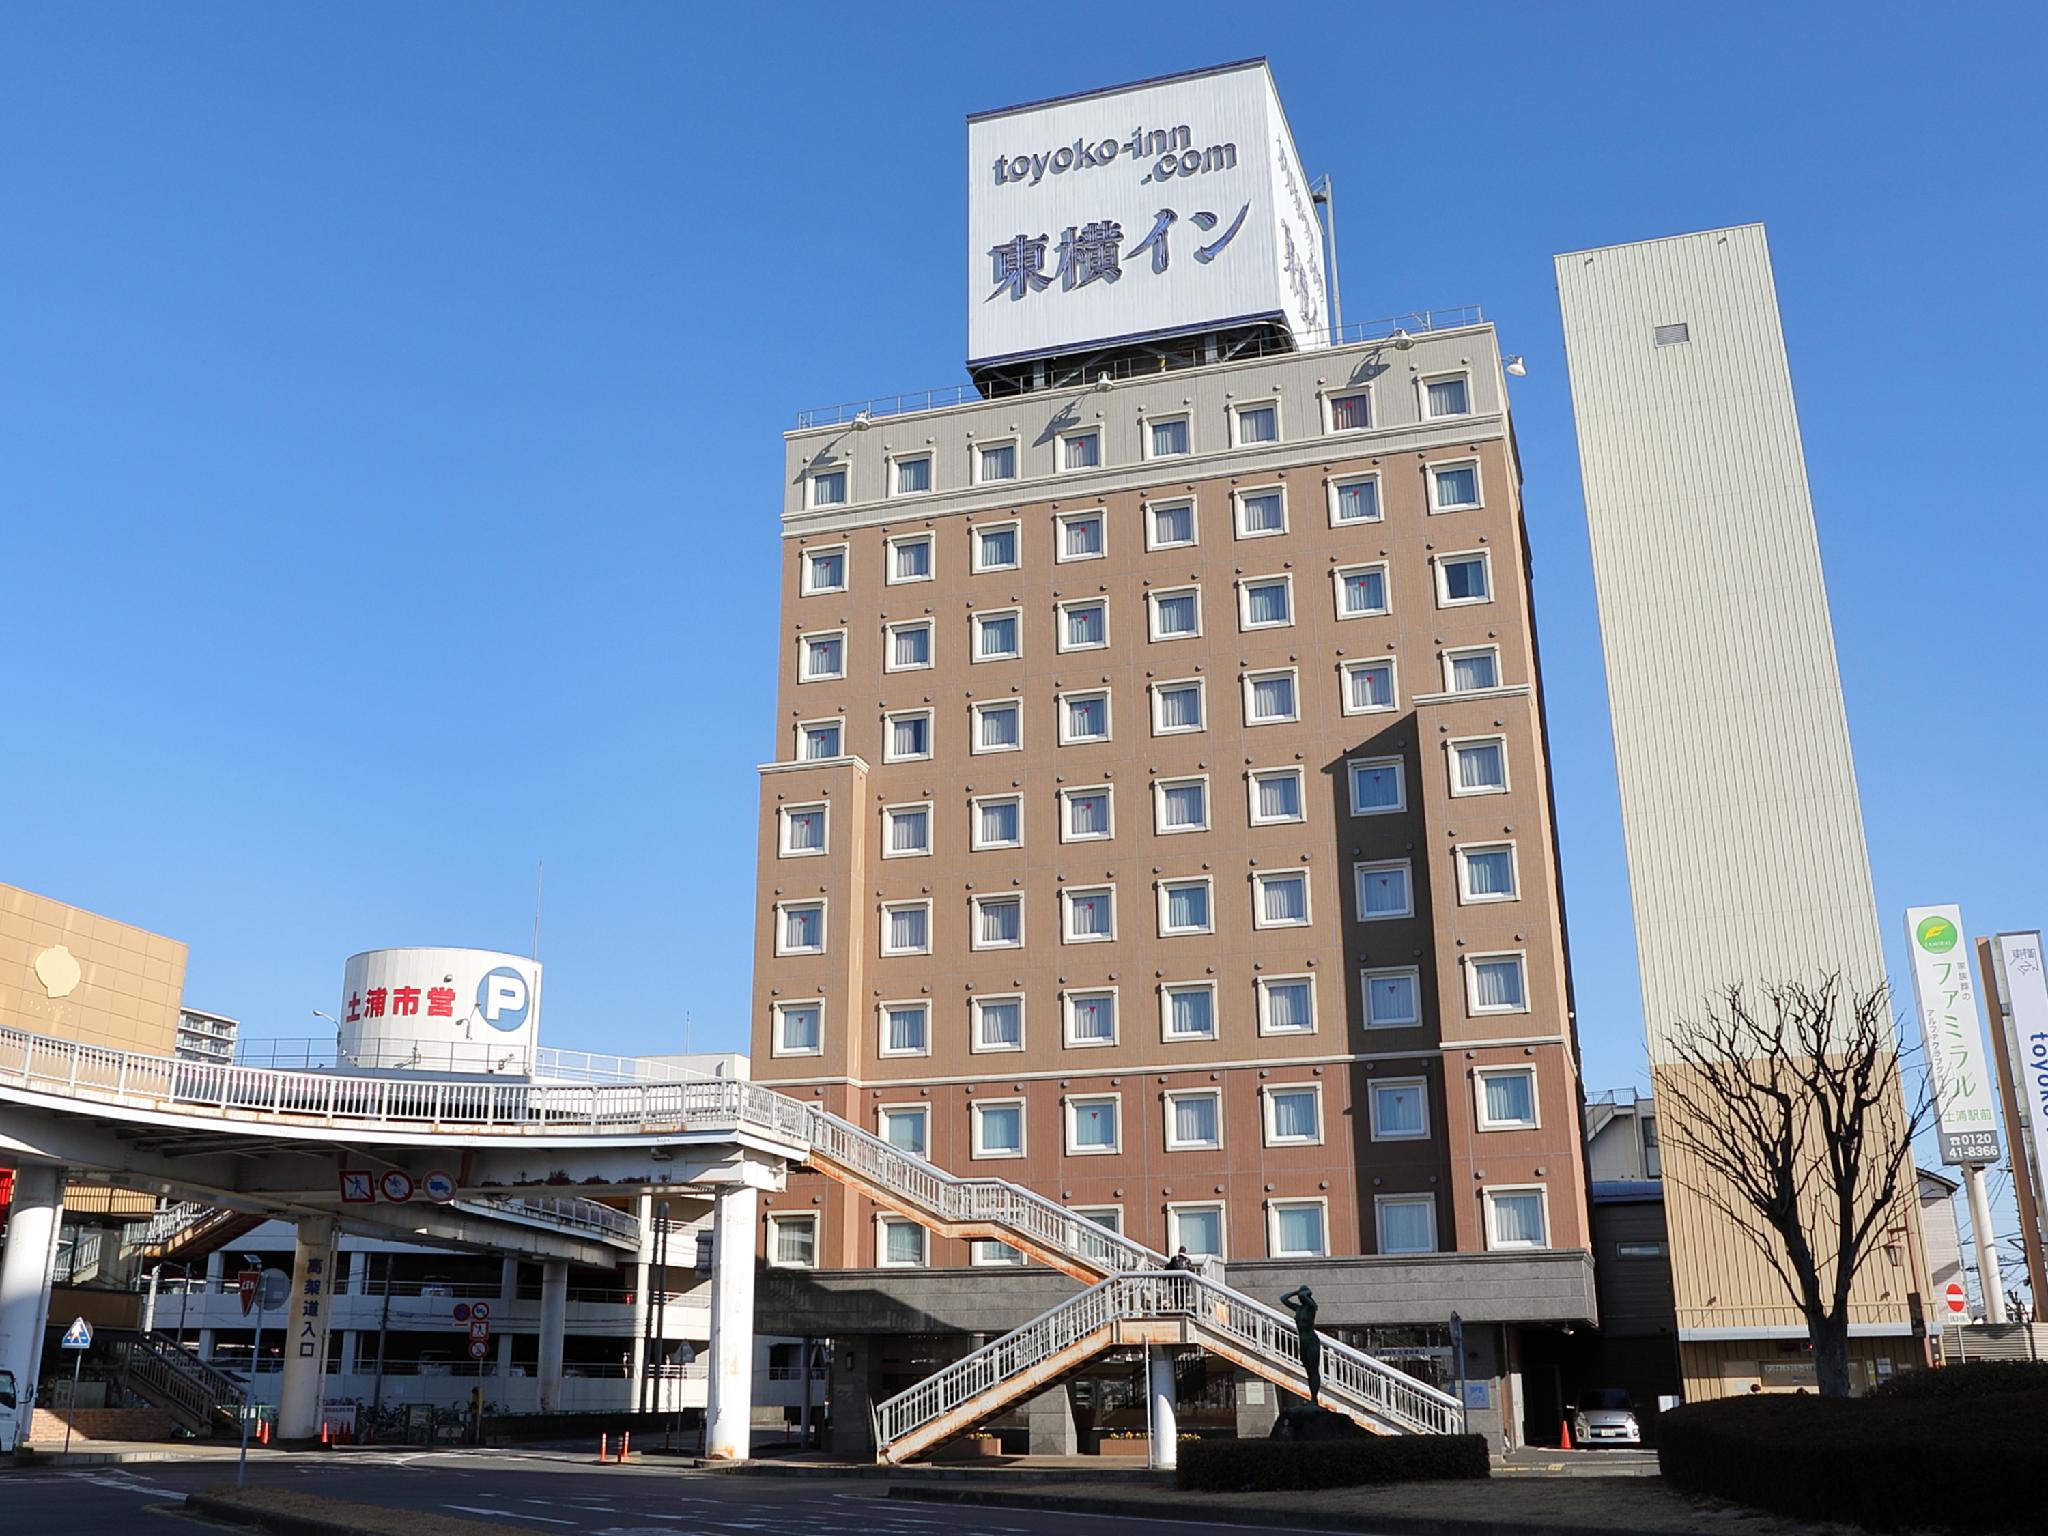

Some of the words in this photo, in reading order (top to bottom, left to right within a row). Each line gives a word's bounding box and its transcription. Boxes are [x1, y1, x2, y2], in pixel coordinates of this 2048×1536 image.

[993, 124, 1191, 187] toyoko-inn
[1141, 142, 1237, 185] .com
[984, 199, 1251, 304] 東横イン
[346, 985, 456, 1023] 土浦市営
[1932, 962, 1976, 1098] ファミラル
[1944, 1109, 1992, 1123] 土浦駅前
[1961, 1134, 1991, 1145] 0120
[299, 1258, 323, 1357] 高架道入口
